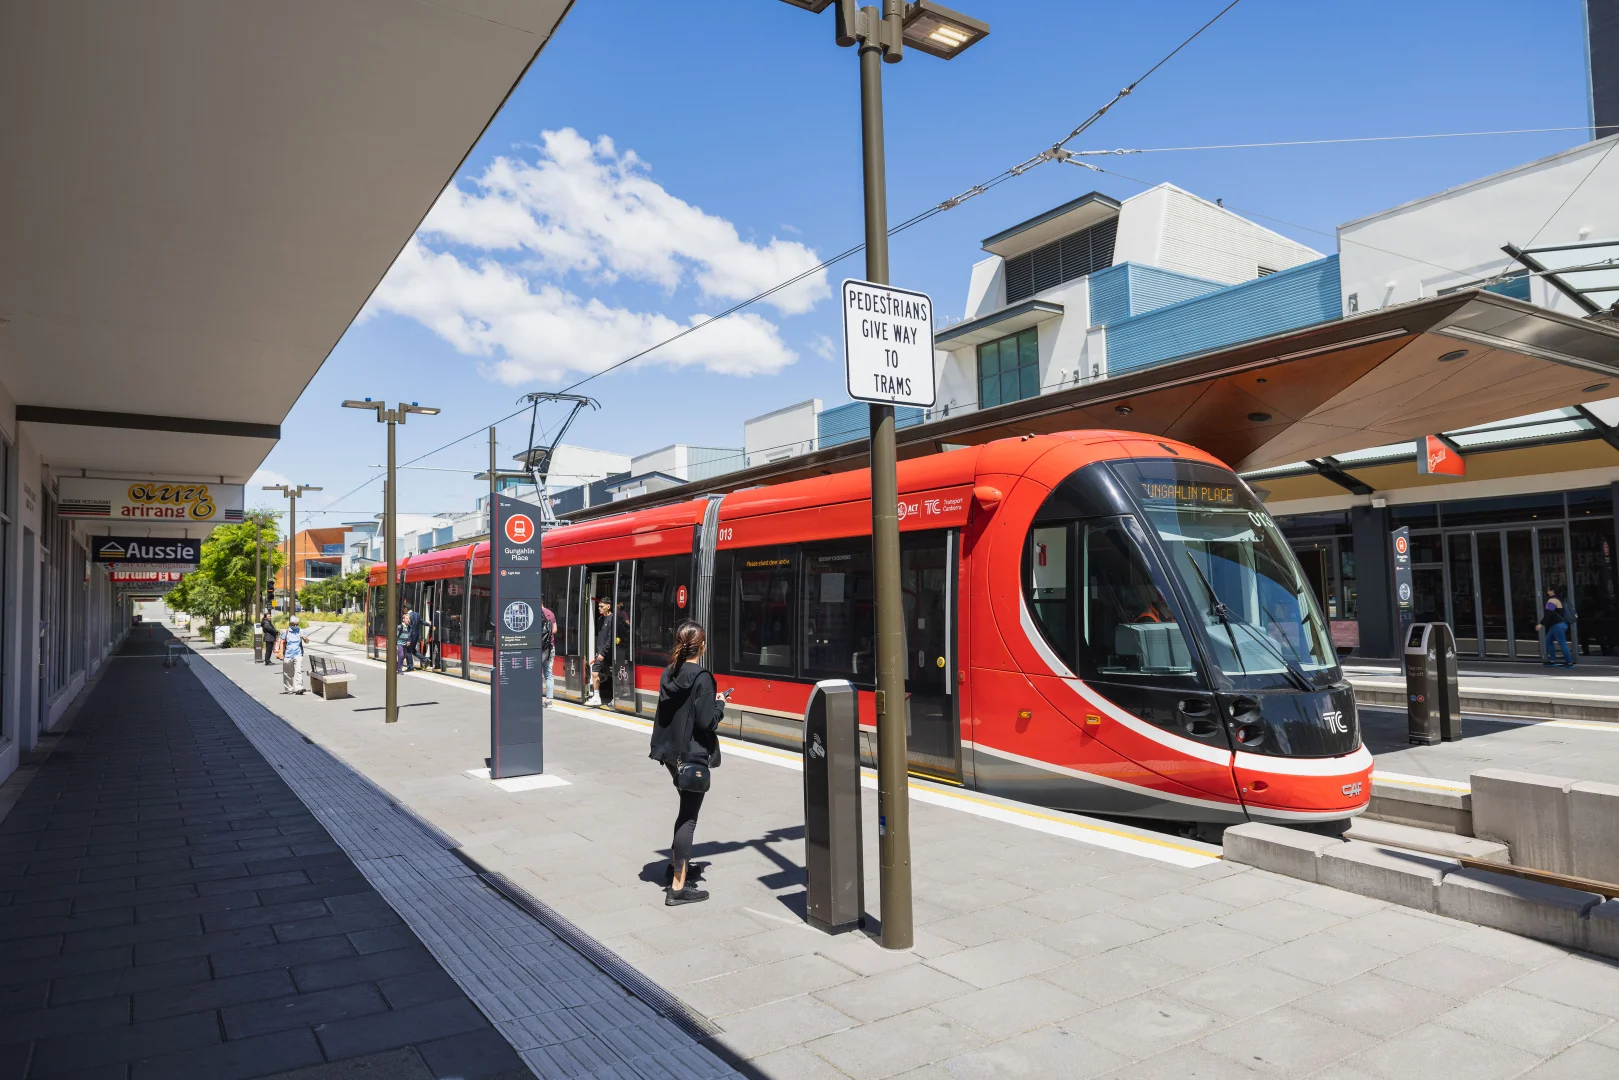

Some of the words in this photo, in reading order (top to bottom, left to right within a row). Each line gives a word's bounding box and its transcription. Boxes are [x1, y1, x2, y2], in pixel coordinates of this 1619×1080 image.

[849, 290, 927, 321] PEDESTRIANS
[862, 319, 888, 341] GIVE
[893, 324, 917, 345] WAY
[885, 349, 898, 368] TO
[873, 374, 911, 396] TRAMS
[1202, 487, 1233, 502] PLACE
[121, 504, 185, 518] arirang
[908, 504, 919, 512] ACT
[924, 499, 941, 515] TC
[1248, 512, 1274, 528] 013
[719, 528, 733, 541] 013
[126, 542, 194, 559] Aussie
[1323, 711, 1348, 734] TC
[1342, 782, 1363, 797] CAF
